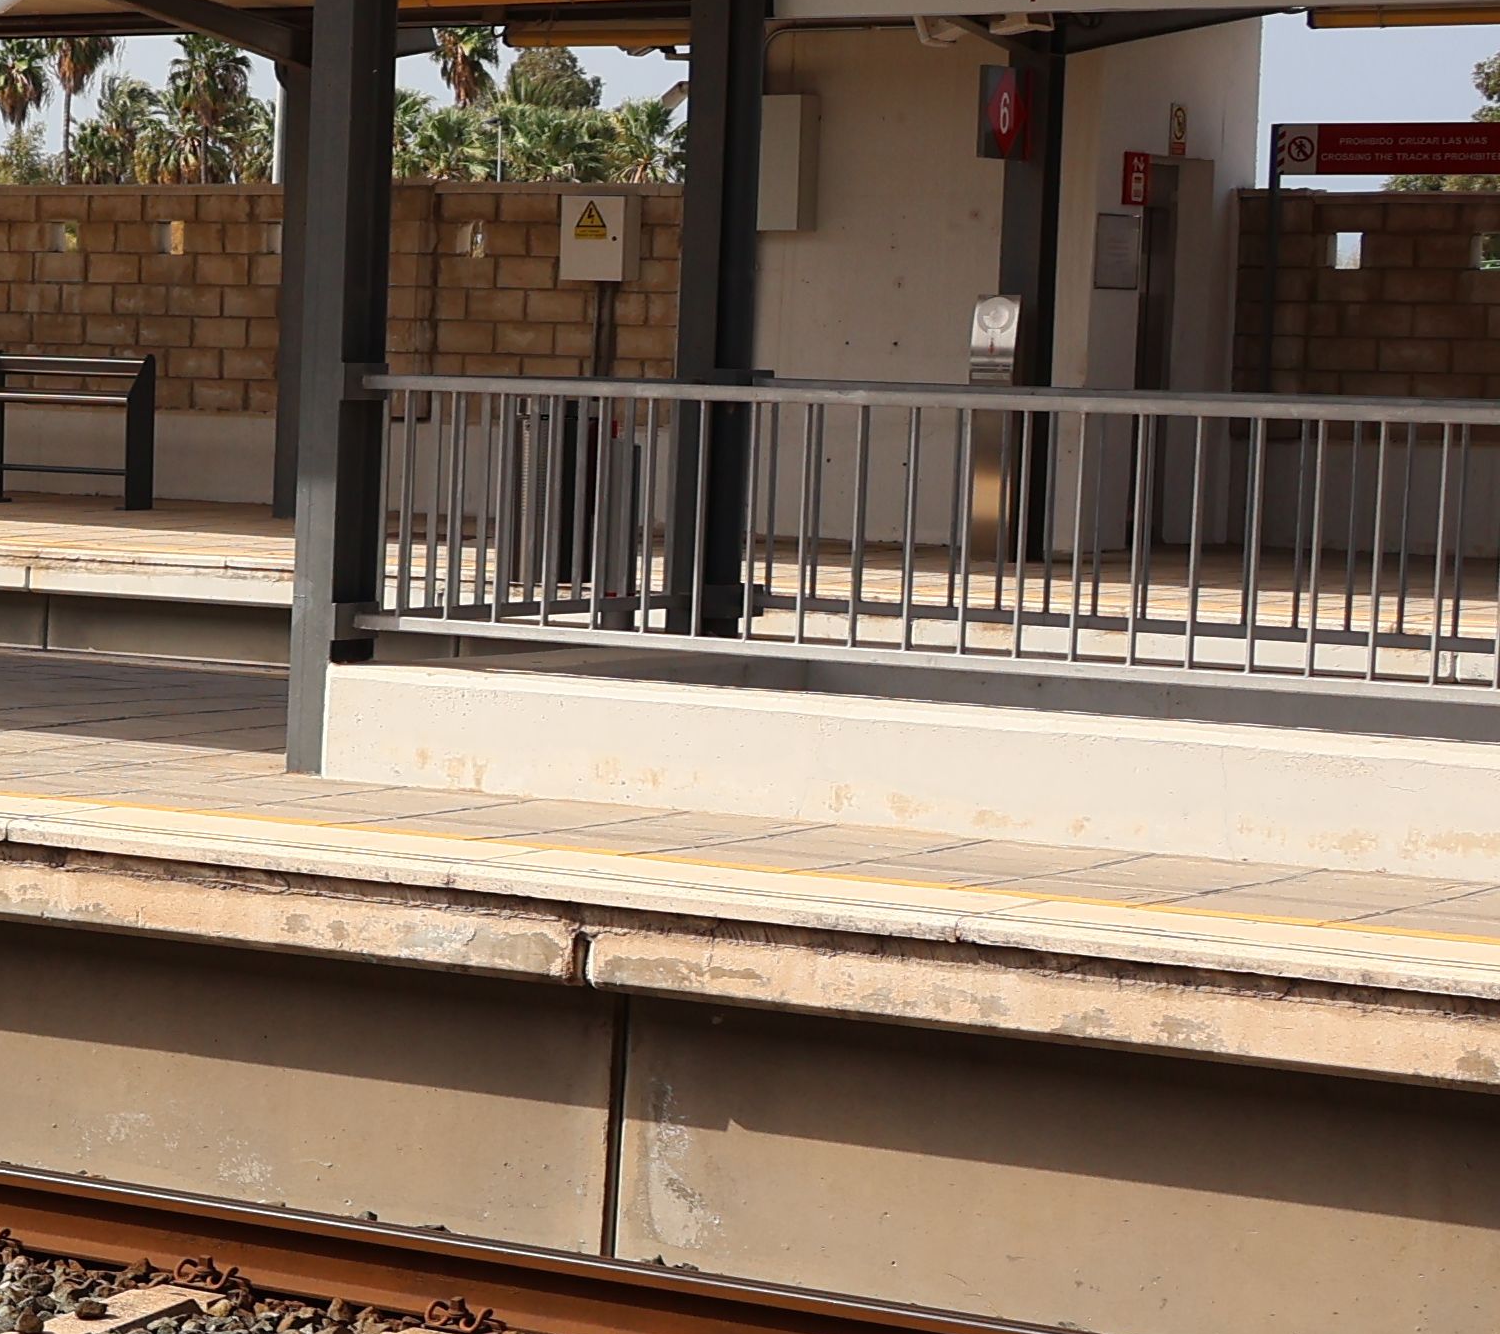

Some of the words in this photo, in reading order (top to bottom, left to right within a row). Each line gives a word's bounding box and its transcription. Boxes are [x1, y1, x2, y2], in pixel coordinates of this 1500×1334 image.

[999, 92, 1011, 134] 6
[1339, 137, 1393, 145] PROHIBIDO
[1398, 137, 1440, 145] CRUZAR
[1442, 136, 1462, 145] LAS
[1321, 153, 1372, 161] CROSSING
[1374, 153, 1393, 161] THE
[1396, 152, 1429, 161] TRACK
[1432, 152, 1441, 160] IS
